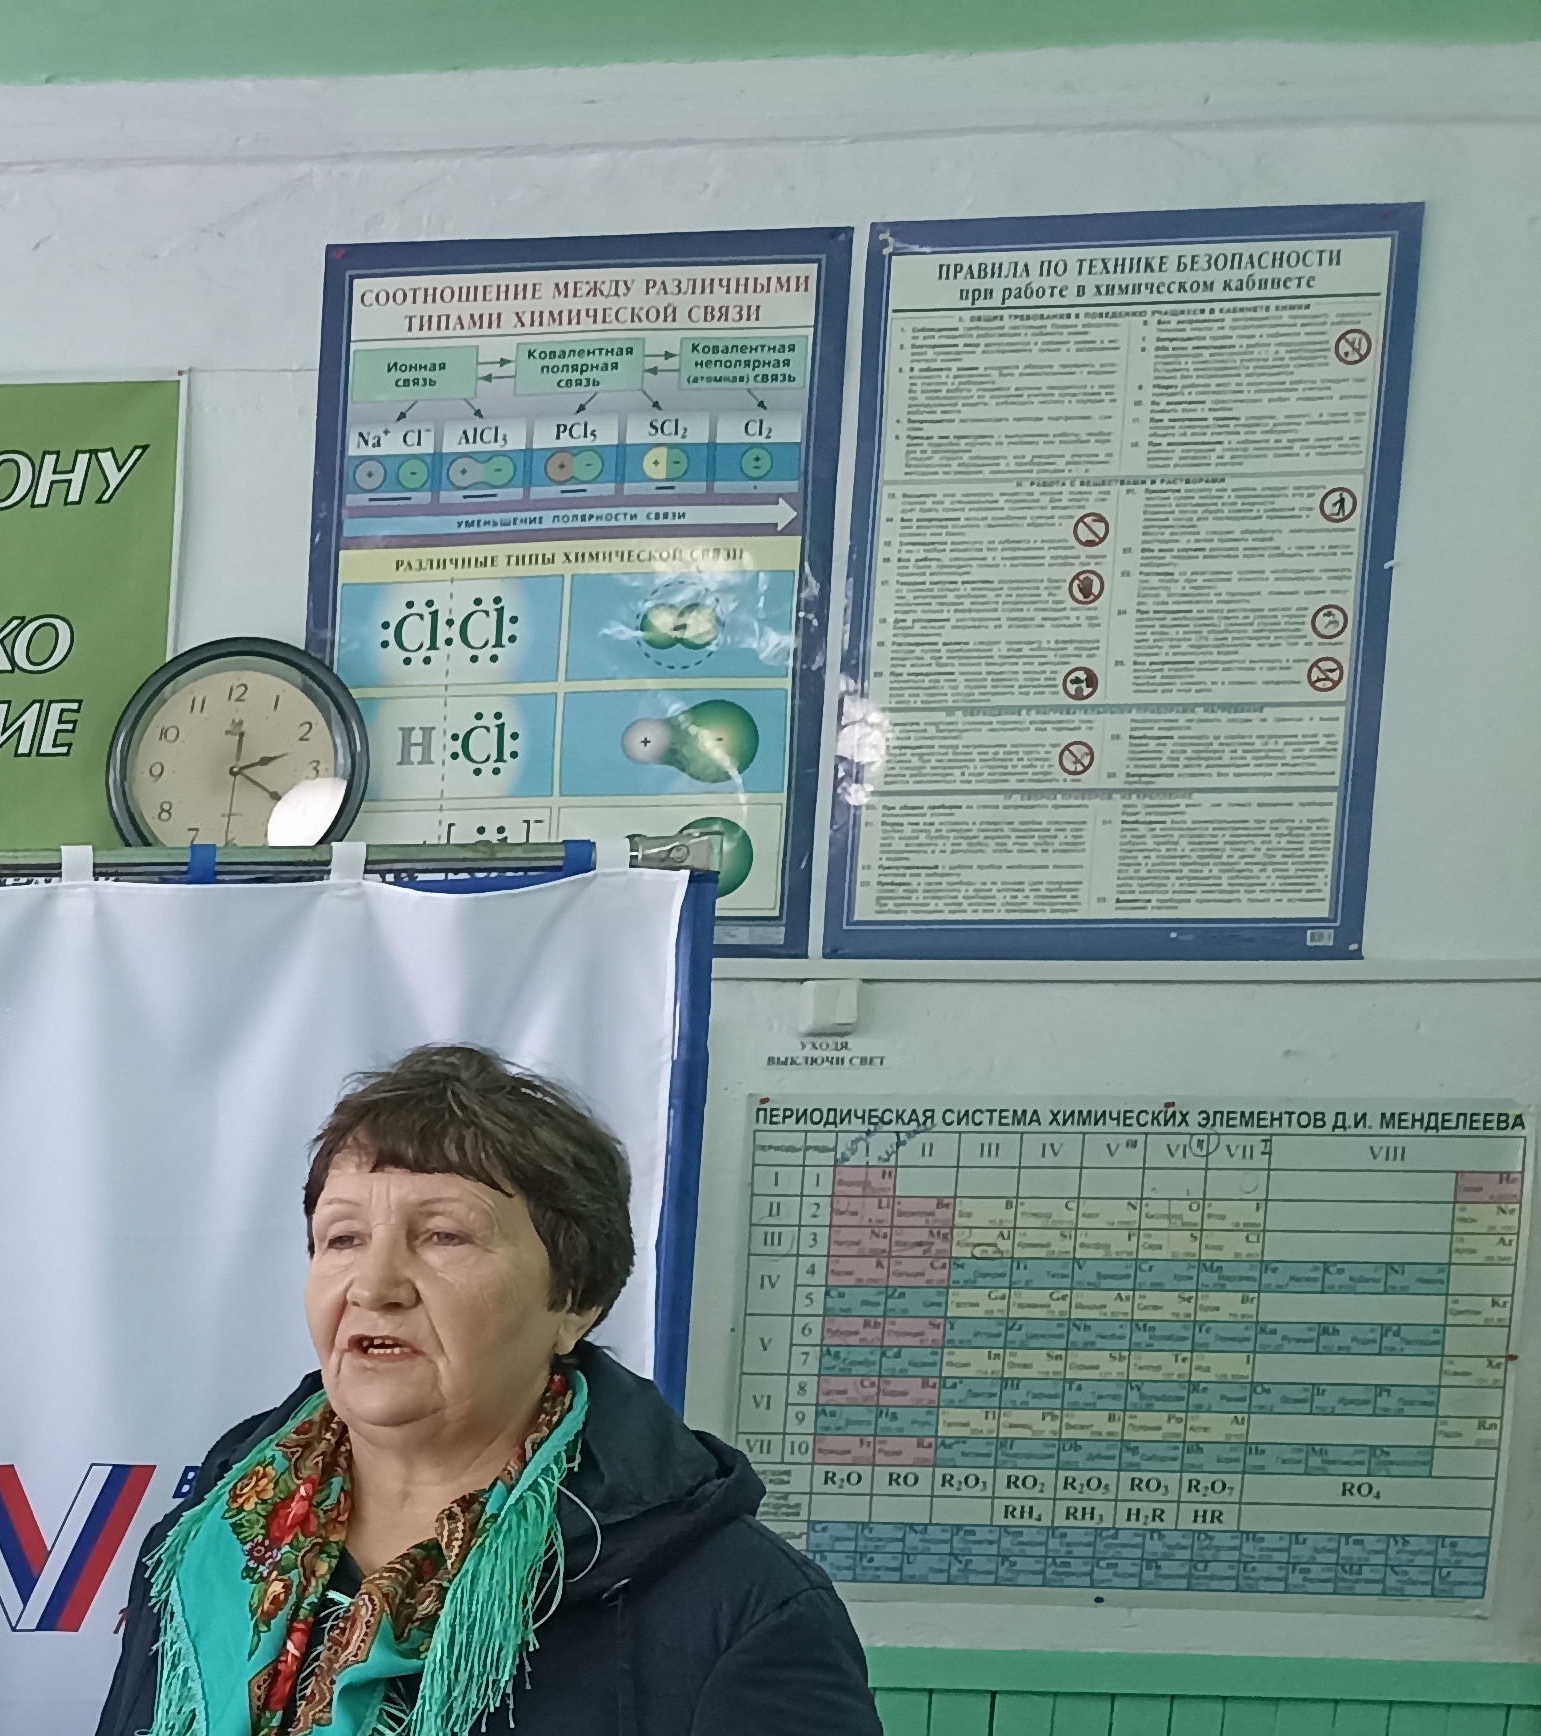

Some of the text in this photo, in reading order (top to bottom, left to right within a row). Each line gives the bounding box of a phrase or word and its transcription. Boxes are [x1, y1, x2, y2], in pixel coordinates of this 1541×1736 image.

[938, 248, 1342, 281] ПРАВИЛА ПО ТЕХНИКЕ БЕЗОПАСНОСТИ
[360, 275, 810, 308] СООТНОШЕНИЕ МЕЖДУ РАЗЛИЧНЫМИ
[959, 274, 1316, 306] при работе в химическом кабинете
[405, 301, 761, 333] ТИПАМИ ХИМИЧЕСКОЙ СВЯЗИ
[527, 344, 634, 362] Ковалентная
[691, 341, 796, 356] Ковалентная
[387, 361, 446, 373] Ионная
[540, 360, 619, 376] полярная
[694, 356, 791, 372] неполярная
[394, 375, 437, 389] связь
[556, 375, 601, 389] связь
[753, 371, 796, 383] связь
[456, 511, 686, 530] УМЕНЬШЕНИЕ ПОЛЯРНОСТИ СВЯЗИ
[395, 555, 498, 573] РАЗЛИЧНЫЕ
[505, 553, 556, 567] ТИПЫ
[228, 683, 248, 702] 12
[190, 695, 206, 713] 11
[273, 694, 279, 711] 1
[159, 725, 180, 743] 10
[298, 721, 313, 741] 2
[397, 727, 436, 766] H
[149, 761, 164, 782] 9
[157, 800, 172, 822] 8
[767, 1056, 886, 1067] ВЫКЛЮЧИ СВЕТ
[755, 1107, 1526, 1131] ПЕРИОДИЧЕСКАЯ СИСТЕМА ХИМИЧЕСКИХ ЭЛЕМЕНТОВ Д.И. МЕНДЕЛЕЕВА
[1369, 1146, 1406, 1161] VIII
[806, 1263, 816, 1276] 4
[759, 1275, 781, 1289] IV
[805, 1292, 814, 1307] 5
[801, 1323, 813, 1337] 6
[759, 1337, 773, 1351] V
[800, 1351, 810, 1365] 7
[797, 1381, 807, 1395] 8
[752, 1395, 772, 1410] VI
[795, 1410, 806, 1425] 9
[746, 1440, 809, 1455] VII 10
[888, 1472, 919, 1487] RO
[1193, 1509, 1223, 1524] HR
